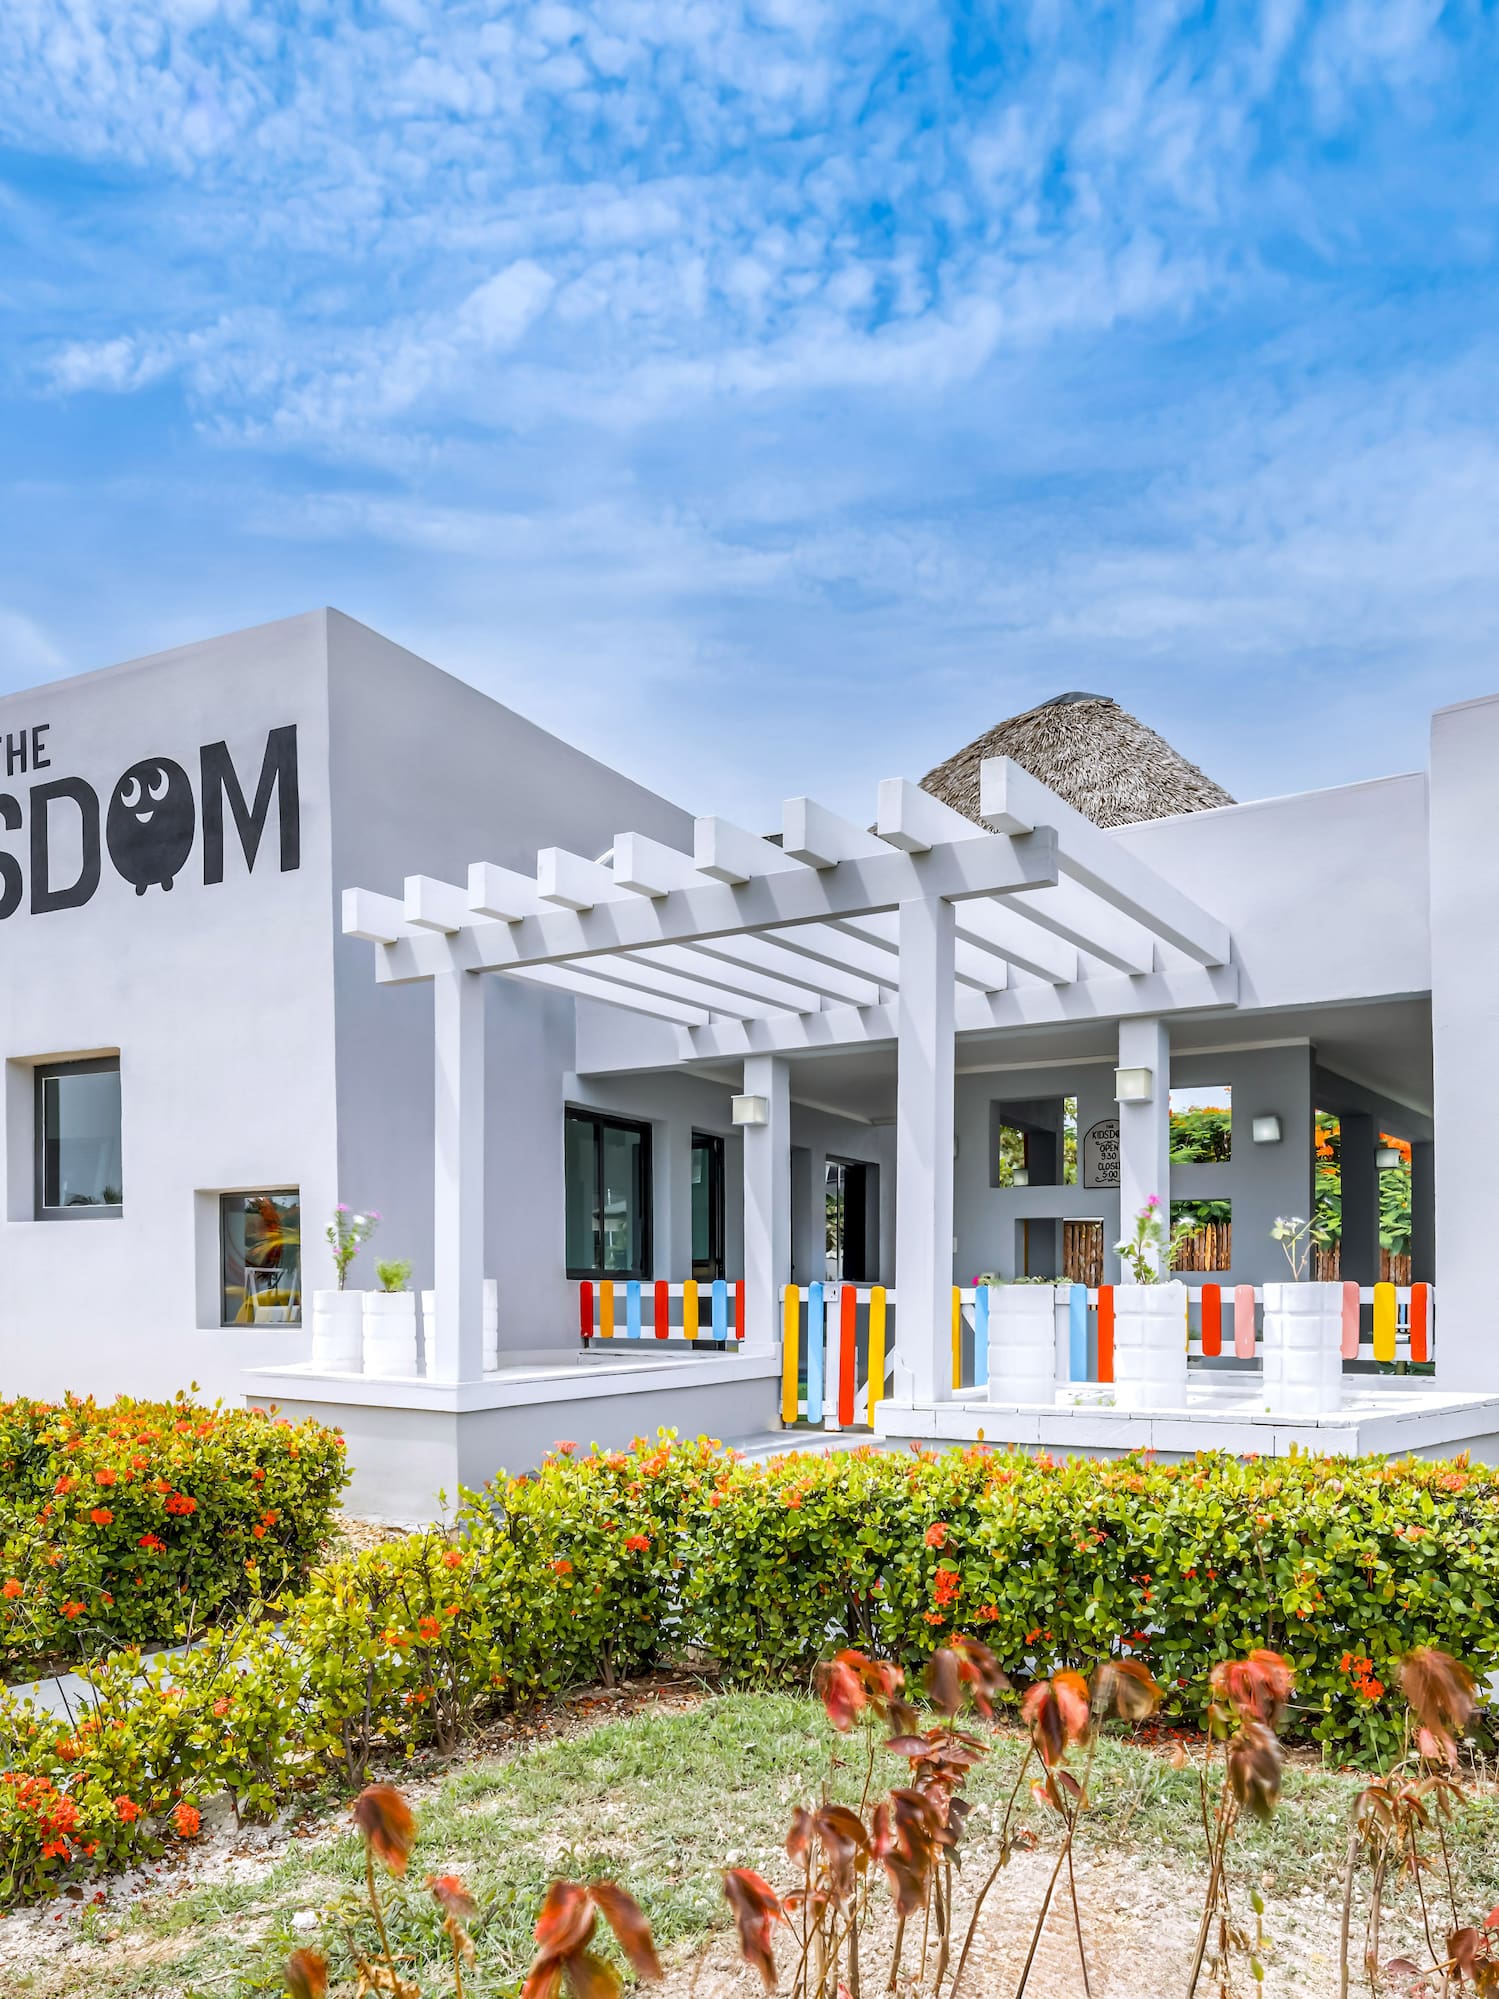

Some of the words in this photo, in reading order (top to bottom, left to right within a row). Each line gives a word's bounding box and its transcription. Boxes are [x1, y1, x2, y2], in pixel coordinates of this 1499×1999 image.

[0, 724, 50, 776] HE
[1099, 1143, 1119, 1152] OPEN
[1097, 1162, 1120, 1171] CLOSE
